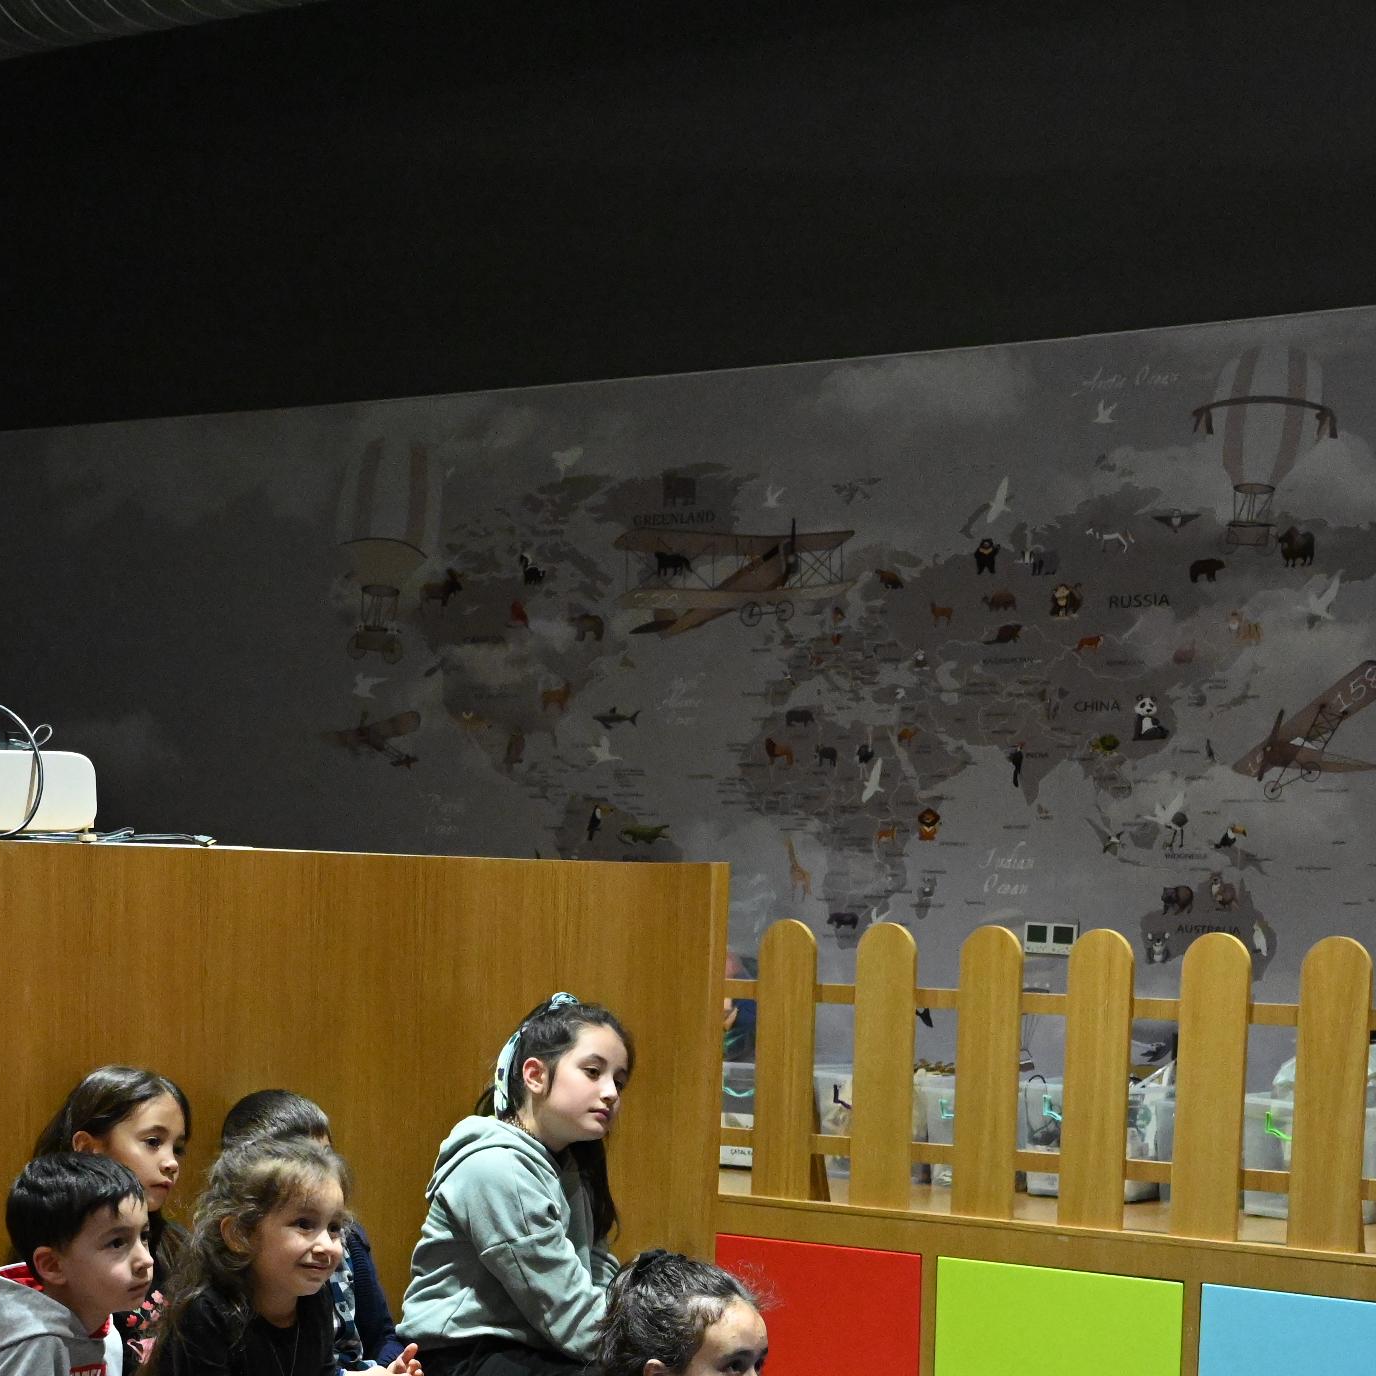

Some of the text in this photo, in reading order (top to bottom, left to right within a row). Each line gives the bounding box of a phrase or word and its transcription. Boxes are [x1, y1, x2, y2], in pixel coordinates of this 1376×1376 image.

[633, 510, 716, 526] GREENLAND
[1109, 593, 1170, 609] RUSSIA
[1073, 700, 1121, 713] CHINA
[1177, 924, 1241, 935] AUSTRALIA
